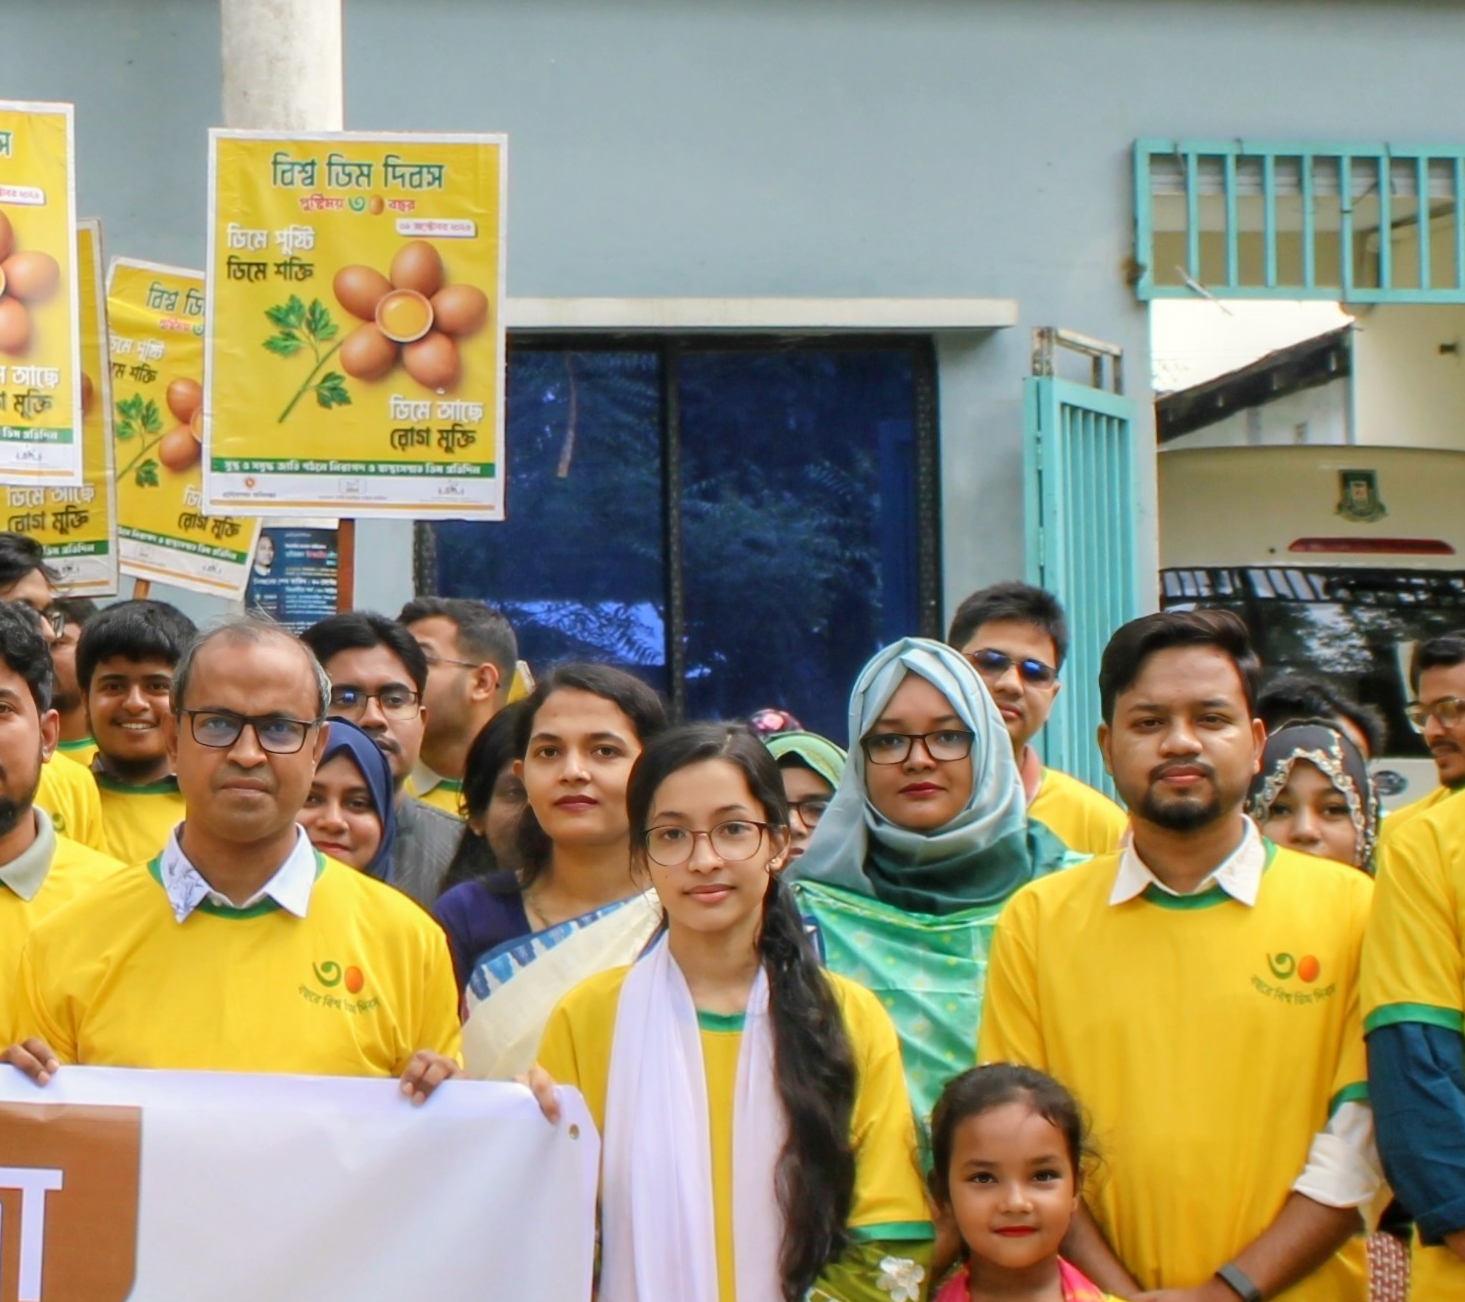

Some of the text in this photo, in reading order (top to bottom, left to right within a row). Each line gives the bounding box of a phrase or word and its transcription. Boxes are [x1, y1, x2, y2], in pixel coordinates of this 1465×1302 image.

[271, 152, 445, 190] বিশ্ব ডিম দিবস
[227, 222, 268, 250] ডিমে
[227, 254, 314, 283] ডিমে শক্তি
[146, 281, 206, 316] বিশ্ব ডি
[12, 364, 60, 388] আছে
[13, 389, 54, 420] মুক্তি
[389, 395, 484, 423] ডিমে আছে
[390, 424, 477, 454] রোগ মুক্তি
[52, 505, 89, 535] মুক্তি
[178, 512, 208, 534] রোগ
